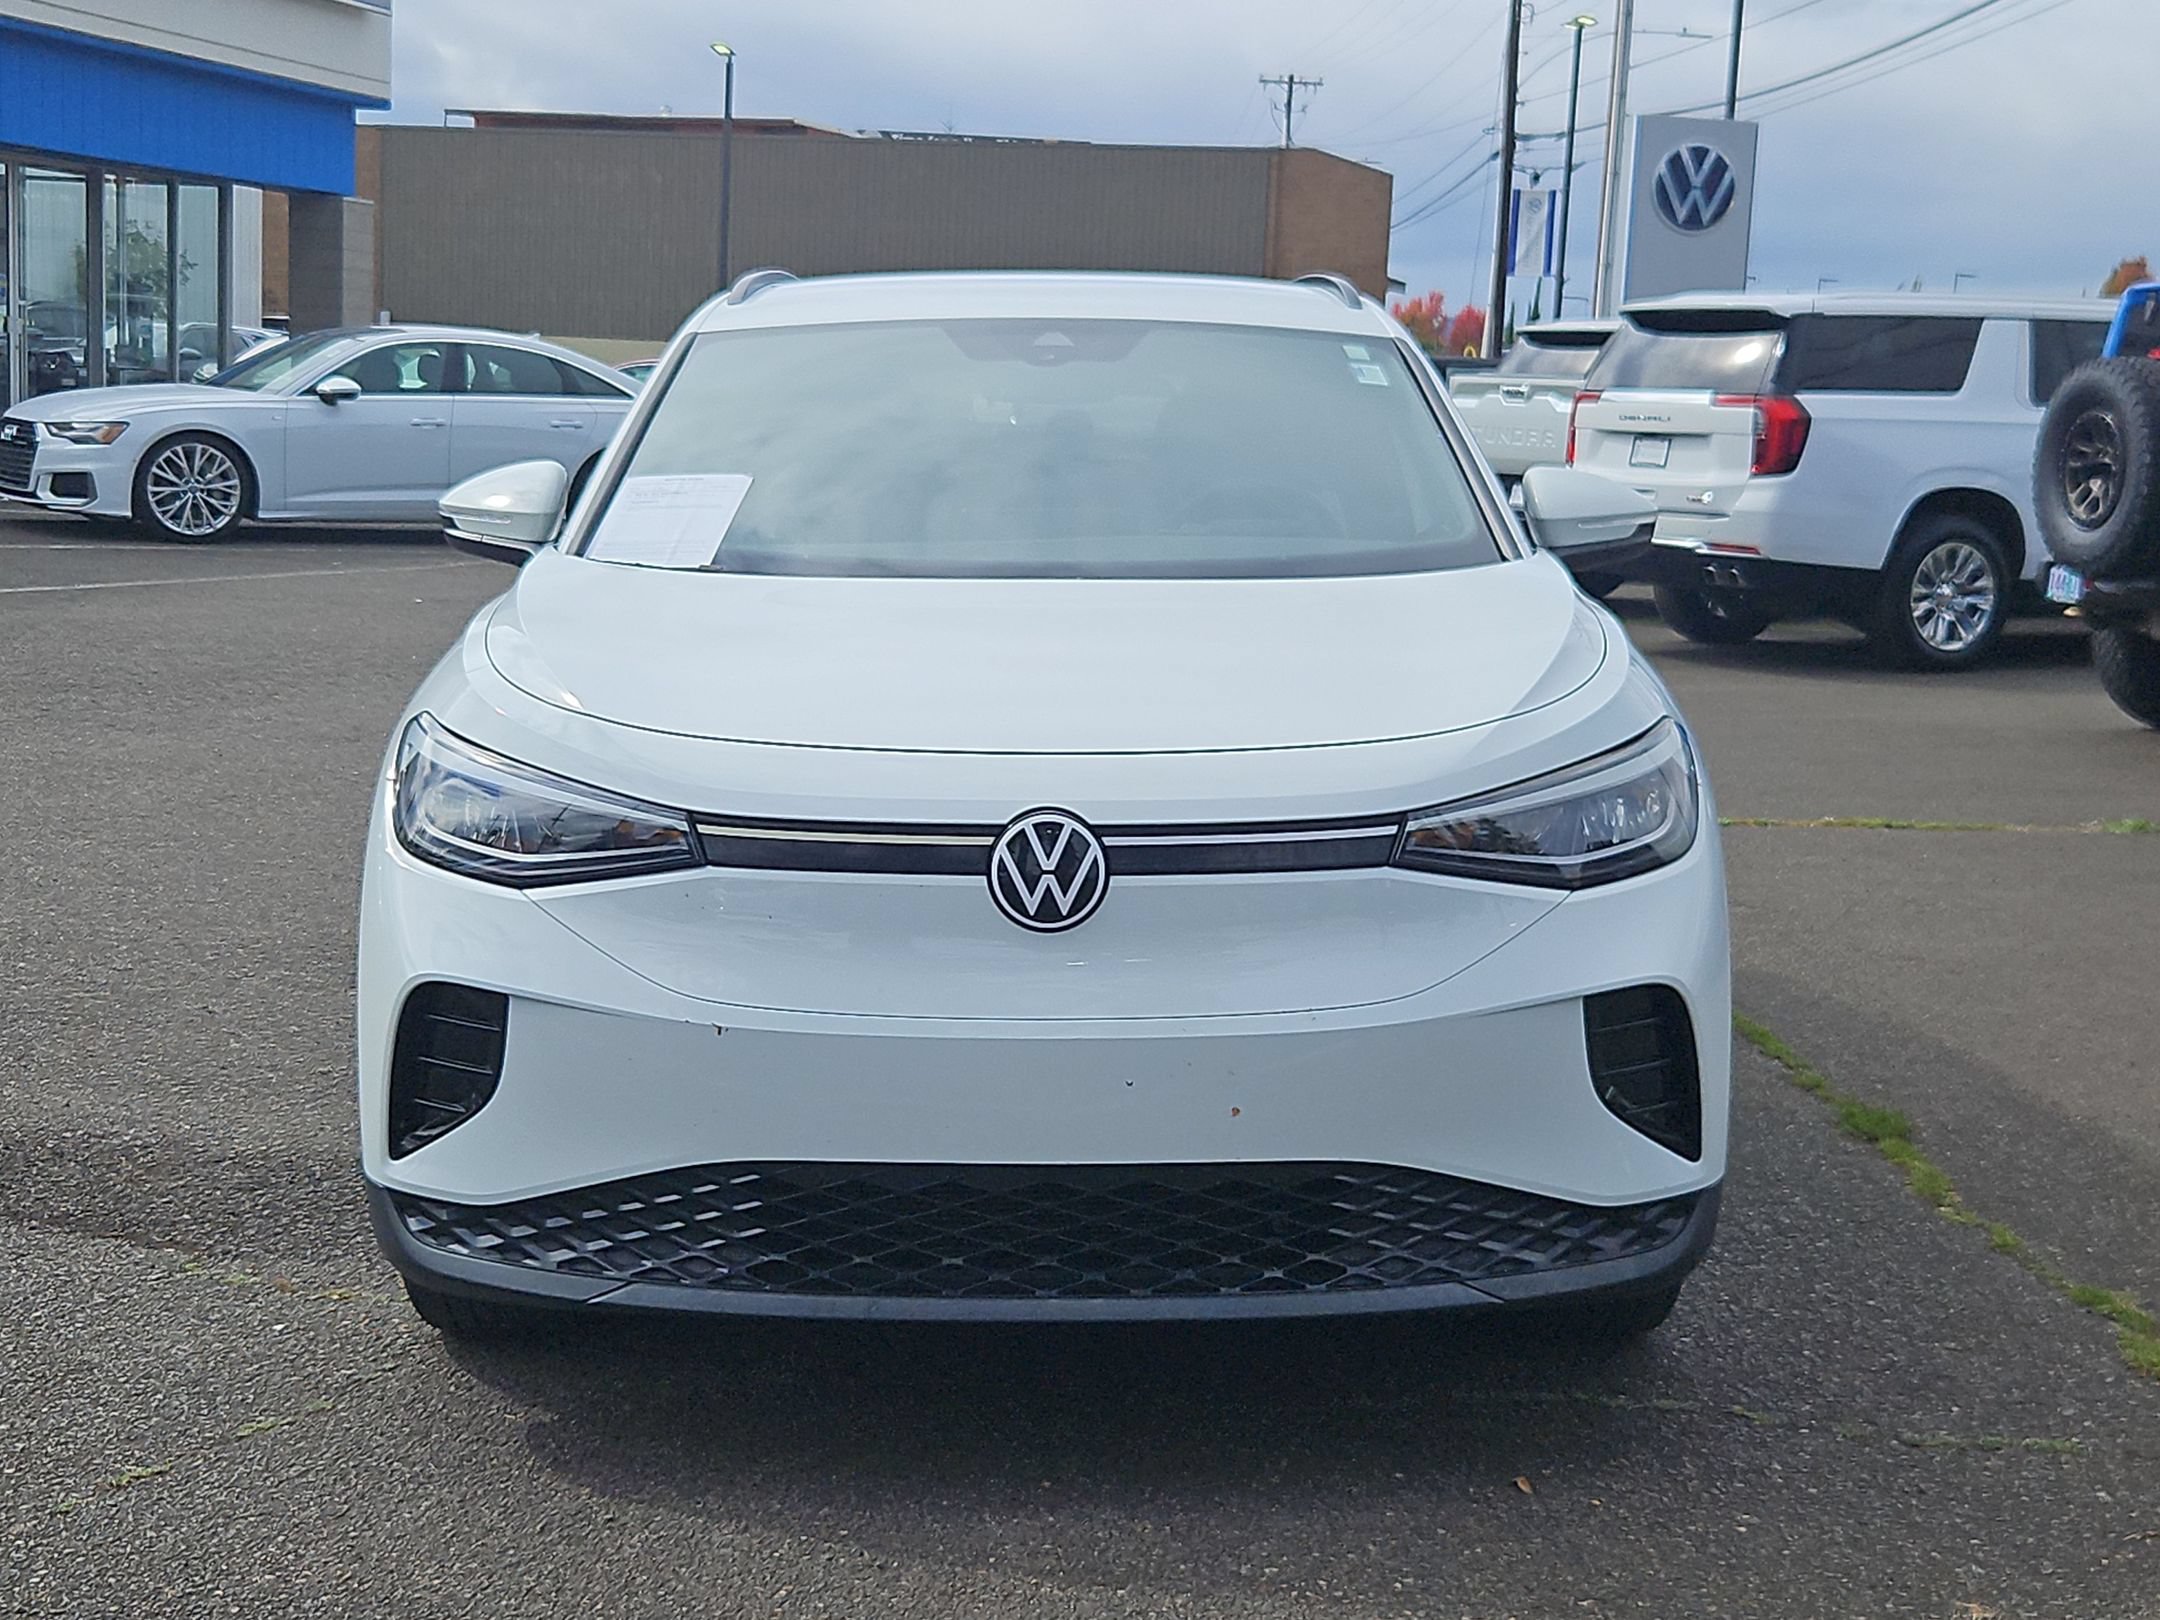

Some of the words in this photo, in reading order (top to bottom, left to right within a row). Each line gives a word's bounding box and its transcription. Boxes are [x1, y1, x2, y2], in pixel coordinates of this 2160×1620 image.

[1655, 144, 1735, 230] VW
[1471, 425, 1556, 448] TUNDRA
[994, 817, 1103, 922] VW
